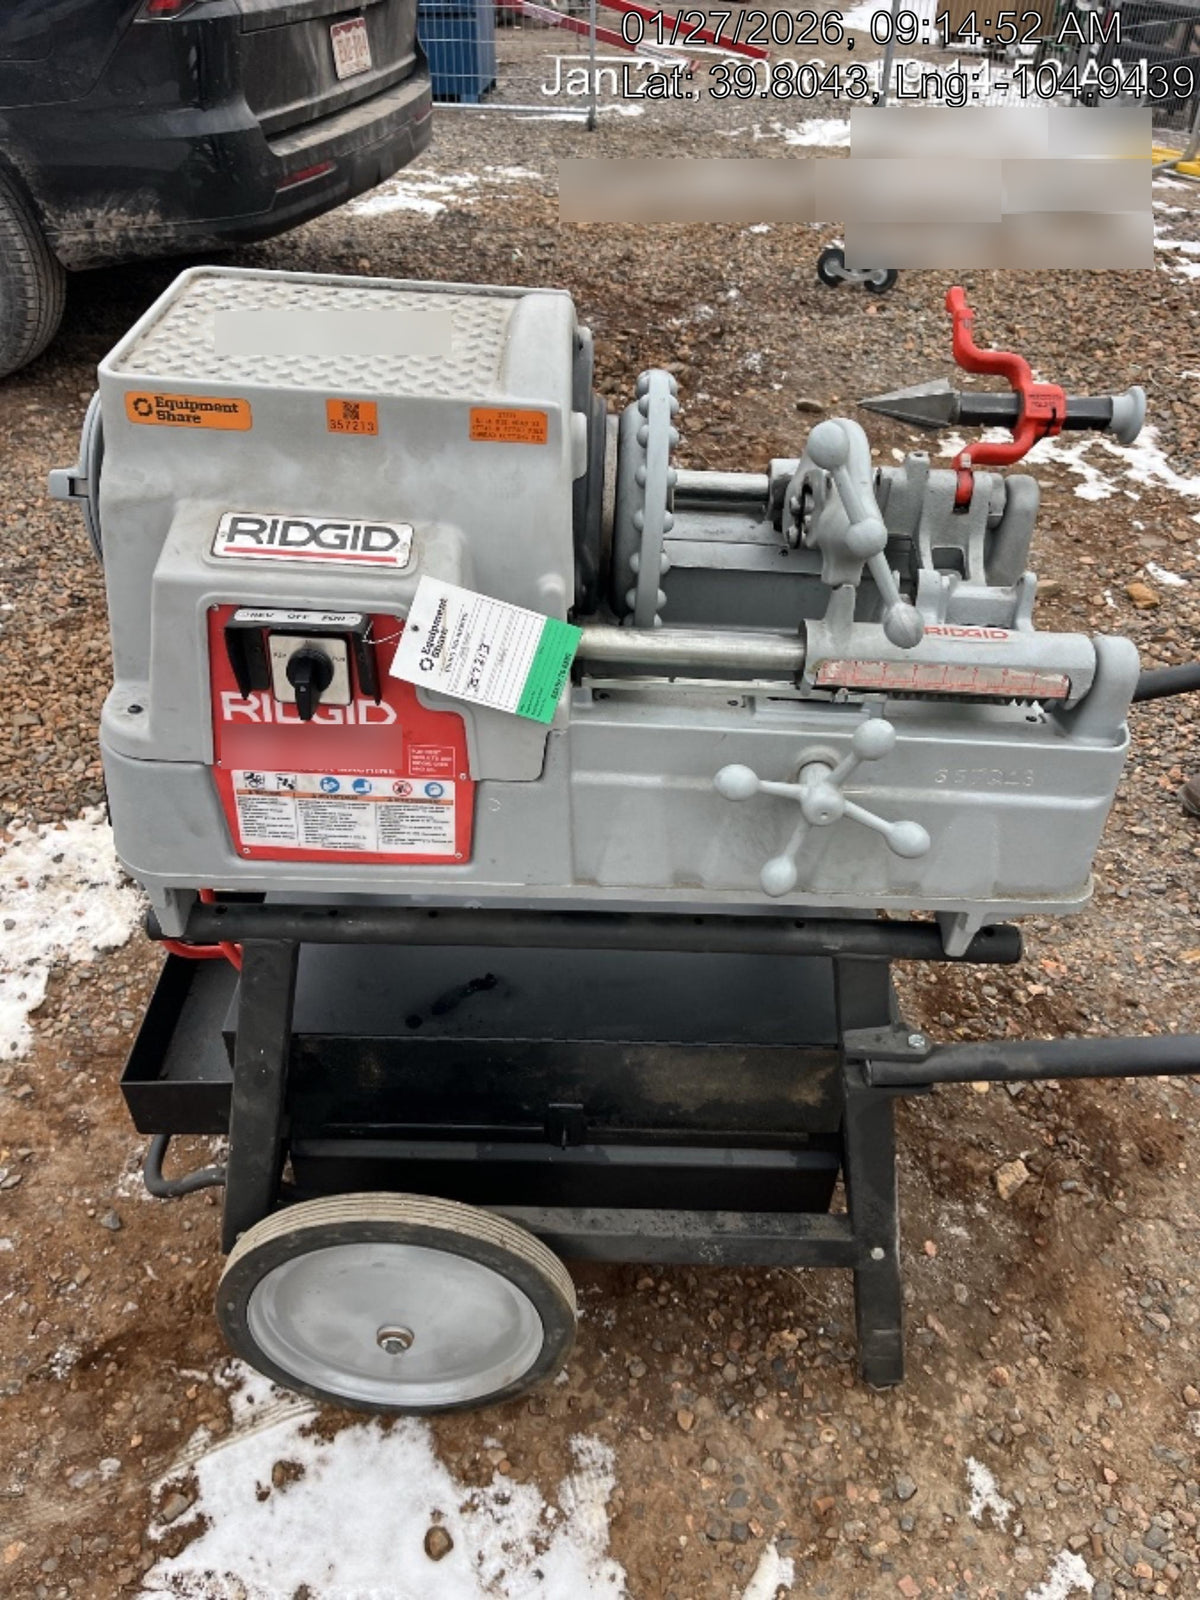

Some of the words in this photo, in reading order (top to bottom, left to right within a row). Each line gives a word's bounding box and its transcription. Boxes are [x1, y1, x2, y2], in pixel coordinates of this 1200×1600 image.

[154, 396, 239, 413] Equipment
[156, 409, 201, 424] Share
[330, 419, 374, 431] 357213
[225, 516, 401, 552] RIDGID
[923, 626, 1009, 640] RIDGID
